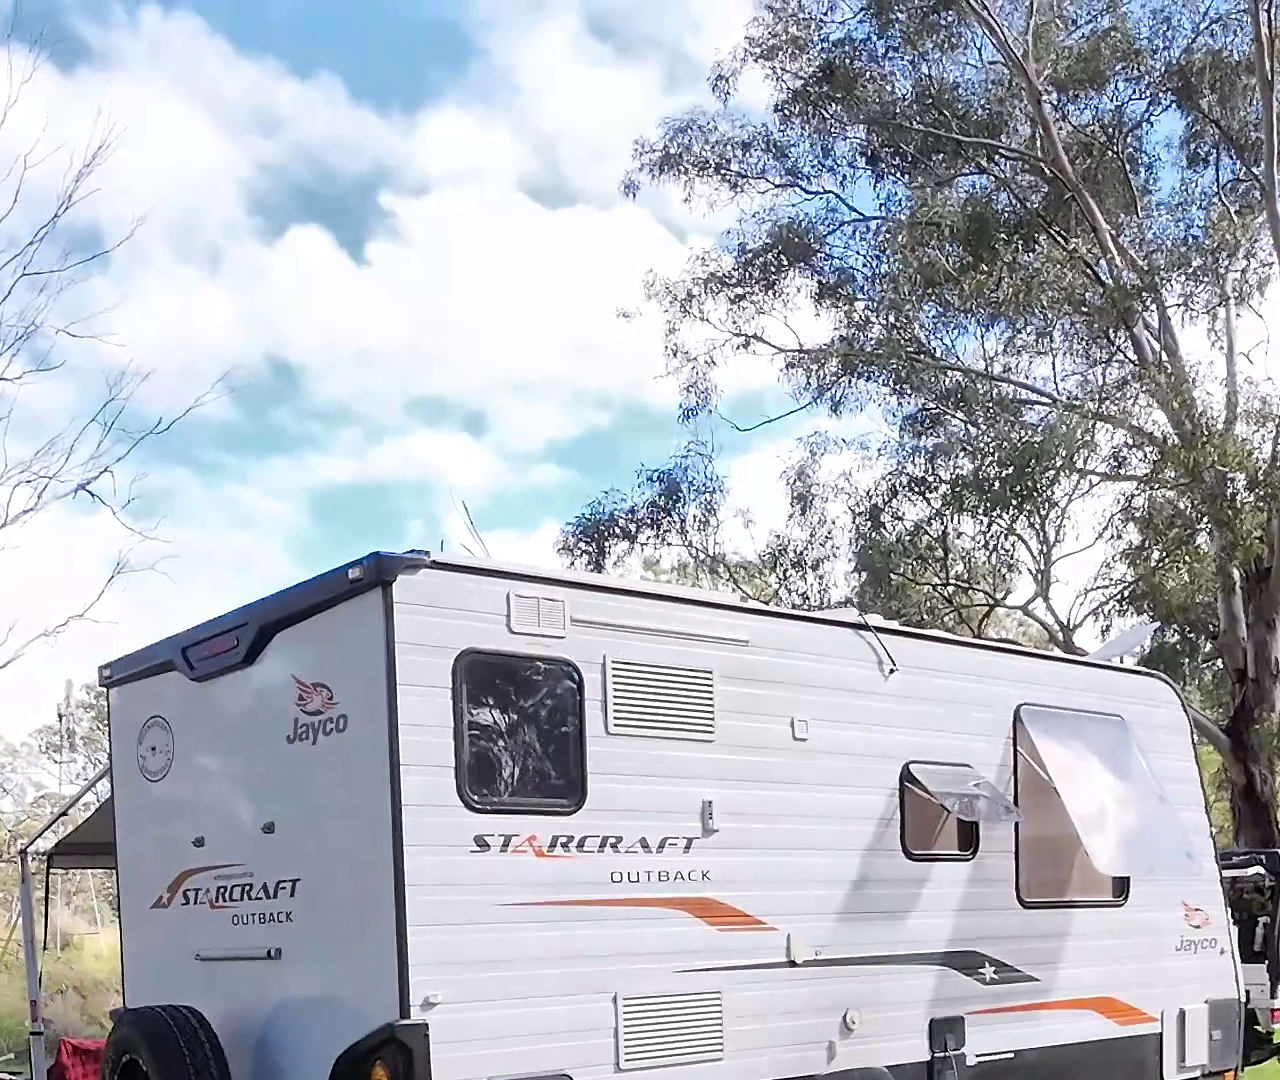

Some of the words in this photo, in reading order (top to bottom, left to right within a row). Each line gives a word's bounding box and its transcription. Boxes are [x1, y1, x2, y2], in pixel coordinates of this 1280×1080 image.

[286, 713, 348, 746] Jayco
[470, 833, 701, 858] STARCRAFT
[610, 870, 712, 884] OUTBACK
[180, 878, 302, 909] STARCRAFT
[232, 911, 294, 926] OUTBACK
